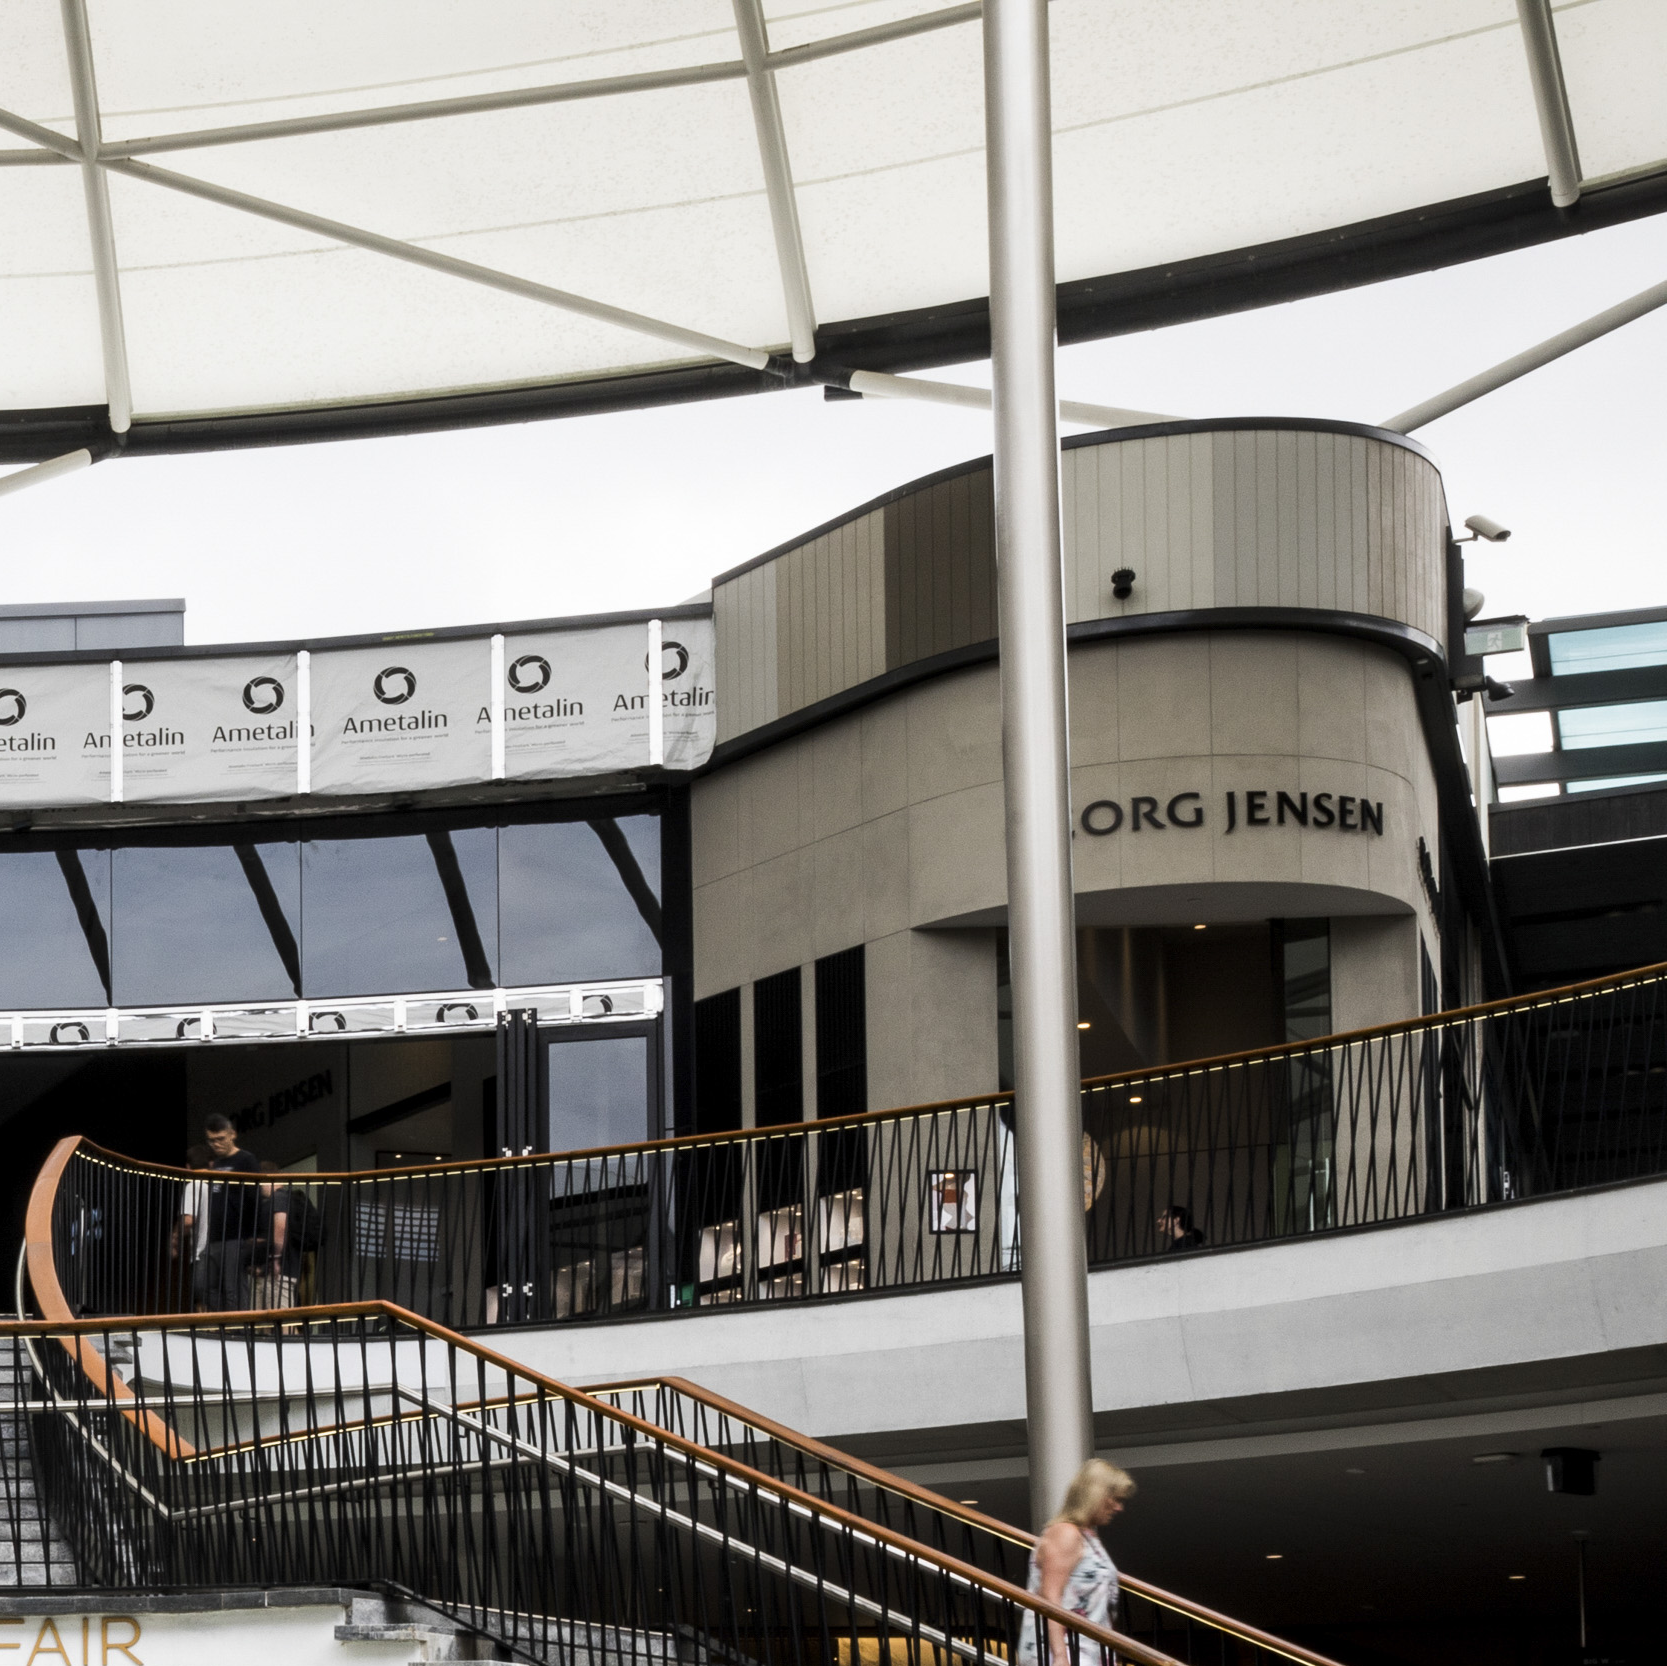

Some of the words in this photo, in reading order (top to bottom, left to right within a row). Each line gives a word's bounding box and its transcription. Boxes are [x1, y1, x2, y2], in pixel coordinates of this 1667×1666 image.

[343, 710, 448, 735] Ametalin
[1072, 791, 1204, 836] ORG
[1224, 790, 1384, 836] JENSEN
